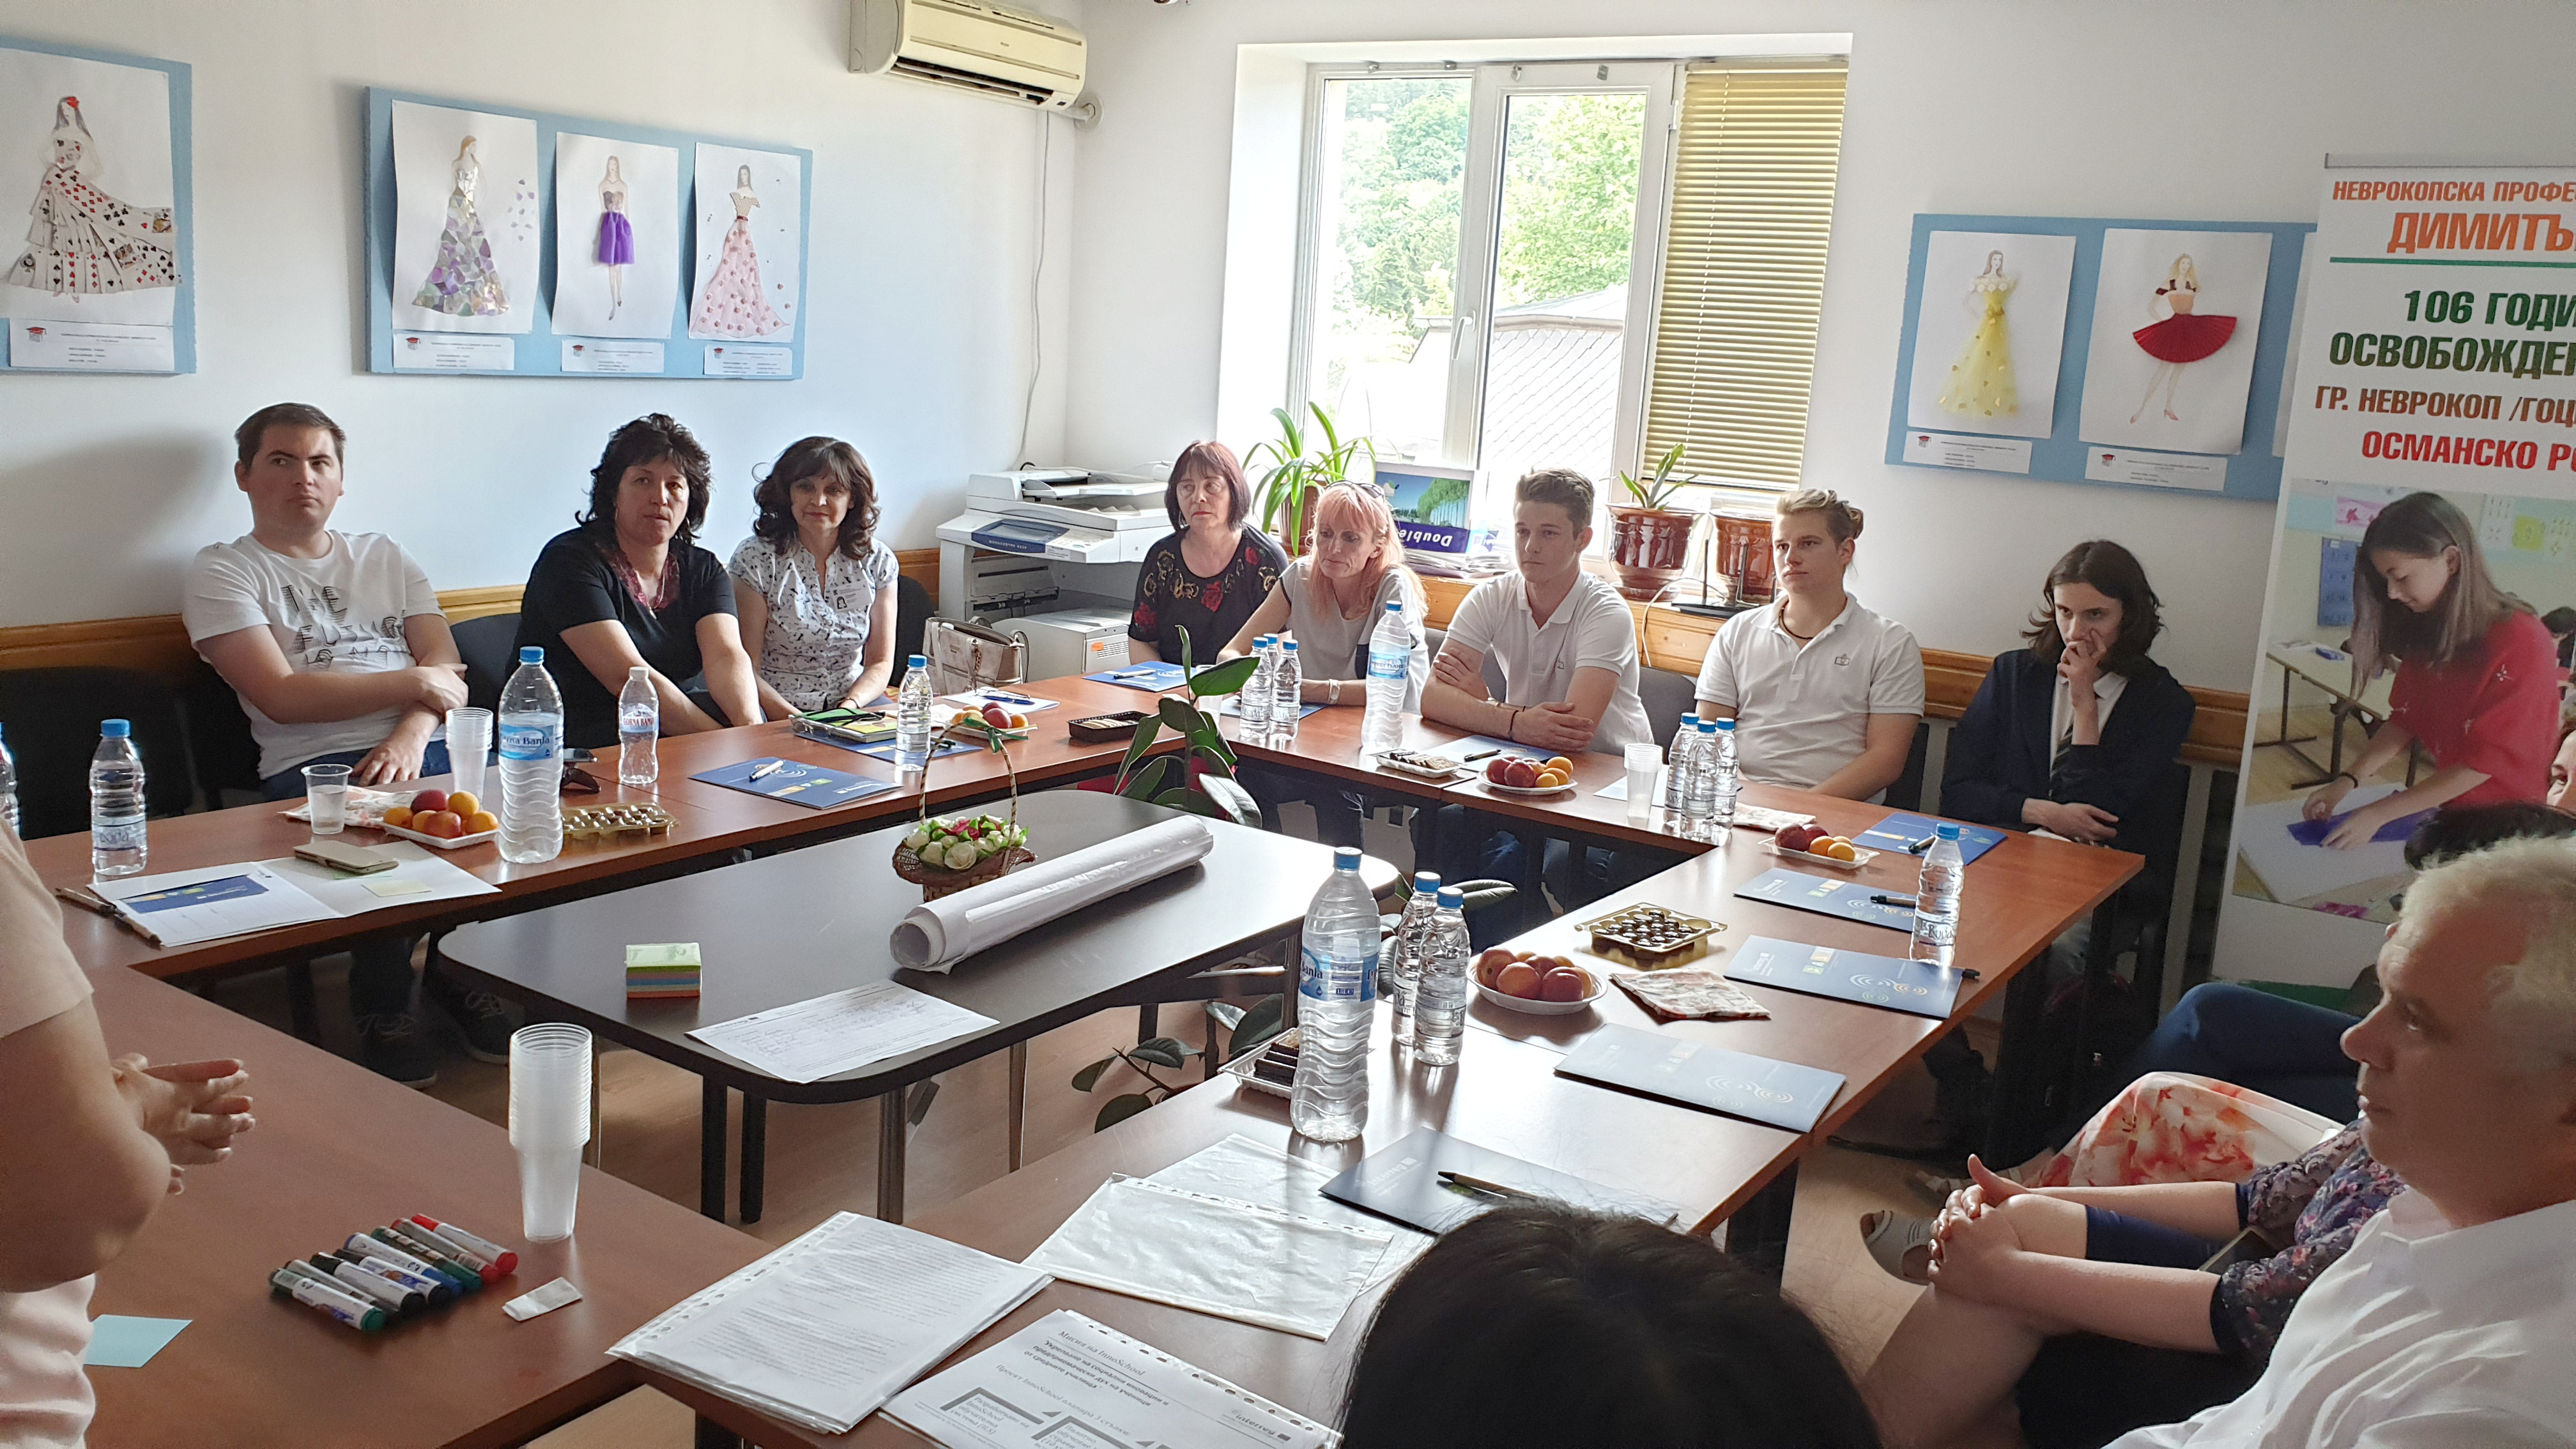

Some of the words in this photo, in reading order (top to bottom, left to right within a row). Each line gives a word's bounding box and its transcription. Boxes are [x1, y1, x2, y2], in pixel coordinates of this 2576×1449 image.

[2332, 181, 2485, 201] НЕВРОКОПСКА
[2492, 181, 2576, 202] ПРОФЕ
[2387, 212, 2576, 254] ДИМИТЪ
[2404, 290, 2474, 323] 106
[2315, 385, 2349, 411] ГР.
[2358, 388, 2503, 420] НЕВРОКОП
[2508, 397, 2576, 428] /ГОЦ
[2361, 431, 2538, 470] ОСМАНСКО
[2547, 443, 2576, 472] Р
[1033, 1355, 1066, 1373] средните
[1057, 1331, 1086, 1347] Мисия
[1086, 1345, 1098, 1353] на
[1098, 1350, 1146, 1377] InnoSchool
[996, 1364, 1023, 1381] Проект
[1023, 1378, 1064, 1401] InnoSchool
[1091, 1365, 1126, 1384] социални
[1126, 1382, 1163, 1403] иновации
[1109, 1383, 1119, 1391] на
[1119, 1388, 1152, 1407] ученици
